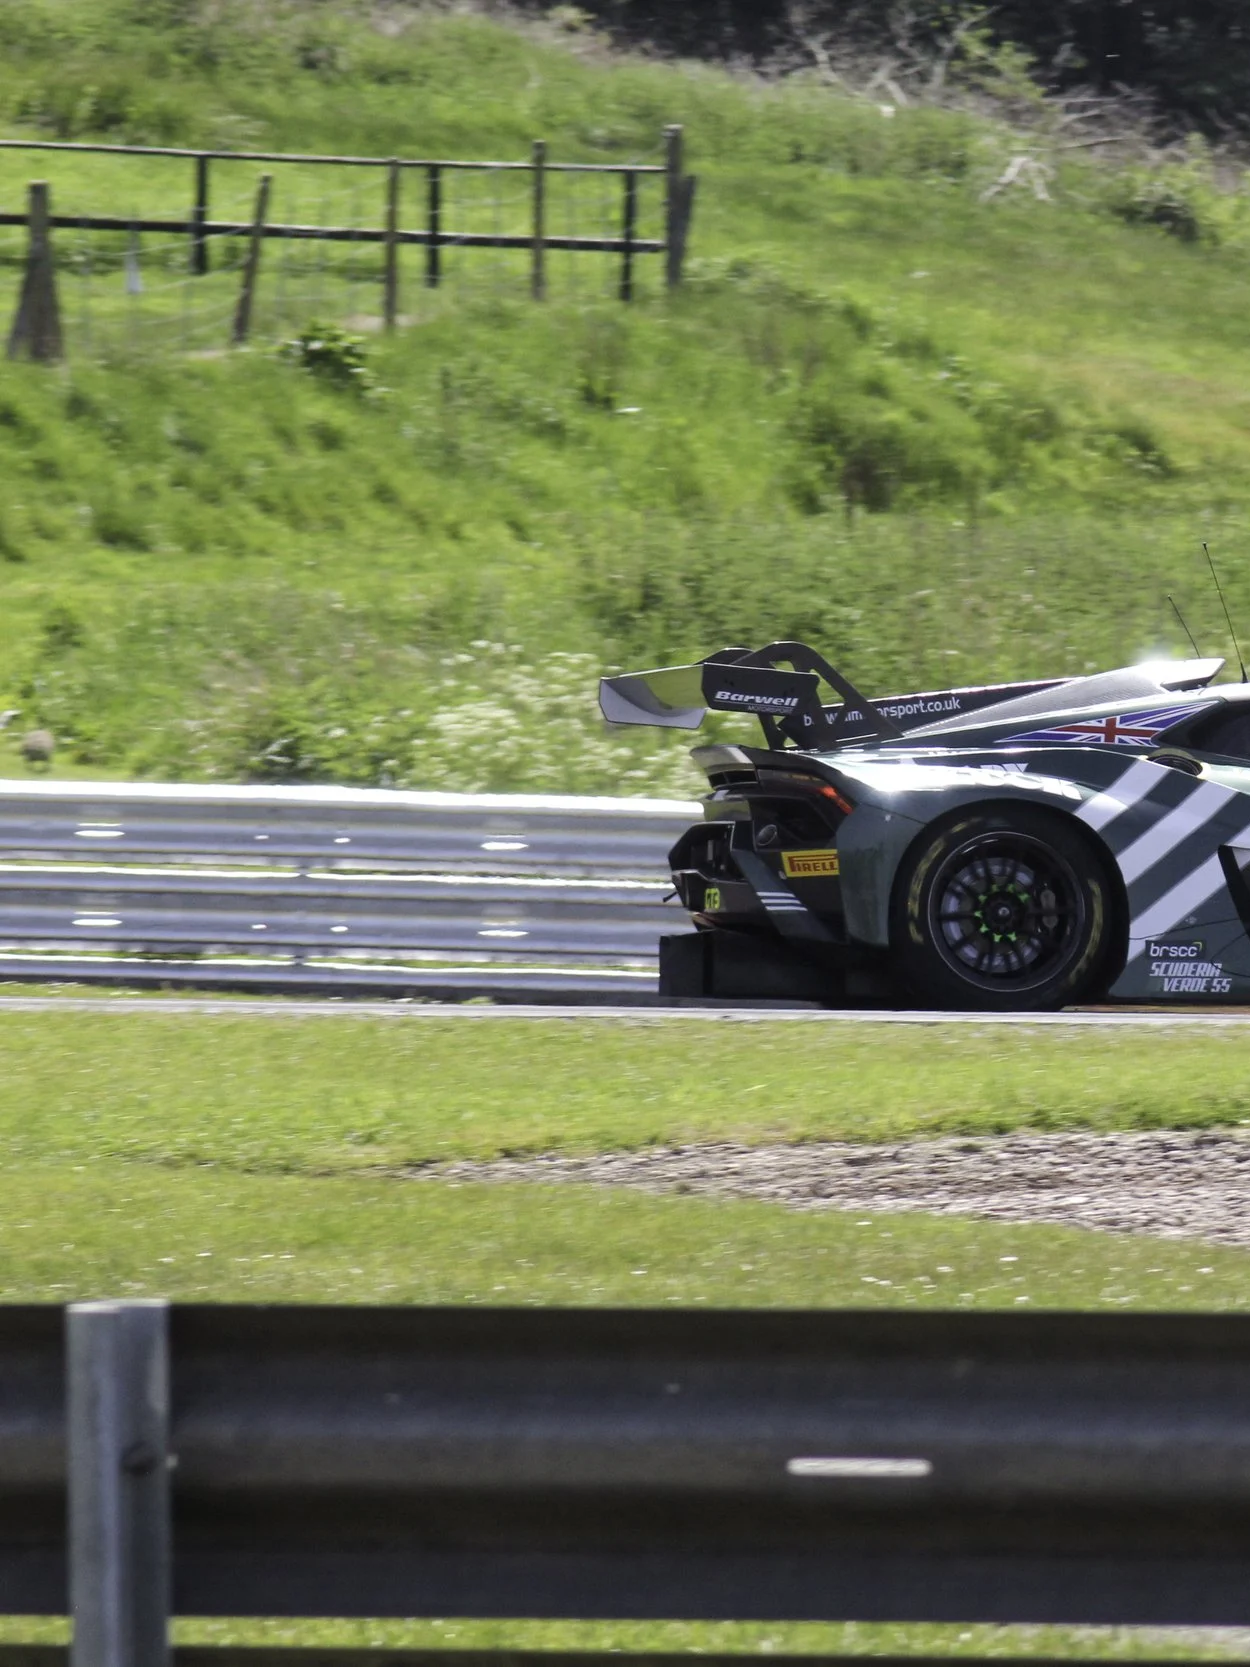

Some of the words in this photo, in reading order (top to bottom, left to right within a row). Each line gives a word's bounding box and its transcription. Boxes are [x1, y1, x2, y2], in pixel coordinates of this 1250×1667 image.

[714, 690, 799, 707] Barwell
[787, 855, 838, 873] PIRELL
[1149, 942, 1199, 958] brscc
[1149, 961, 1222, 977] SCUDERIA
[1163, 977, 1211, 993] VERDE
